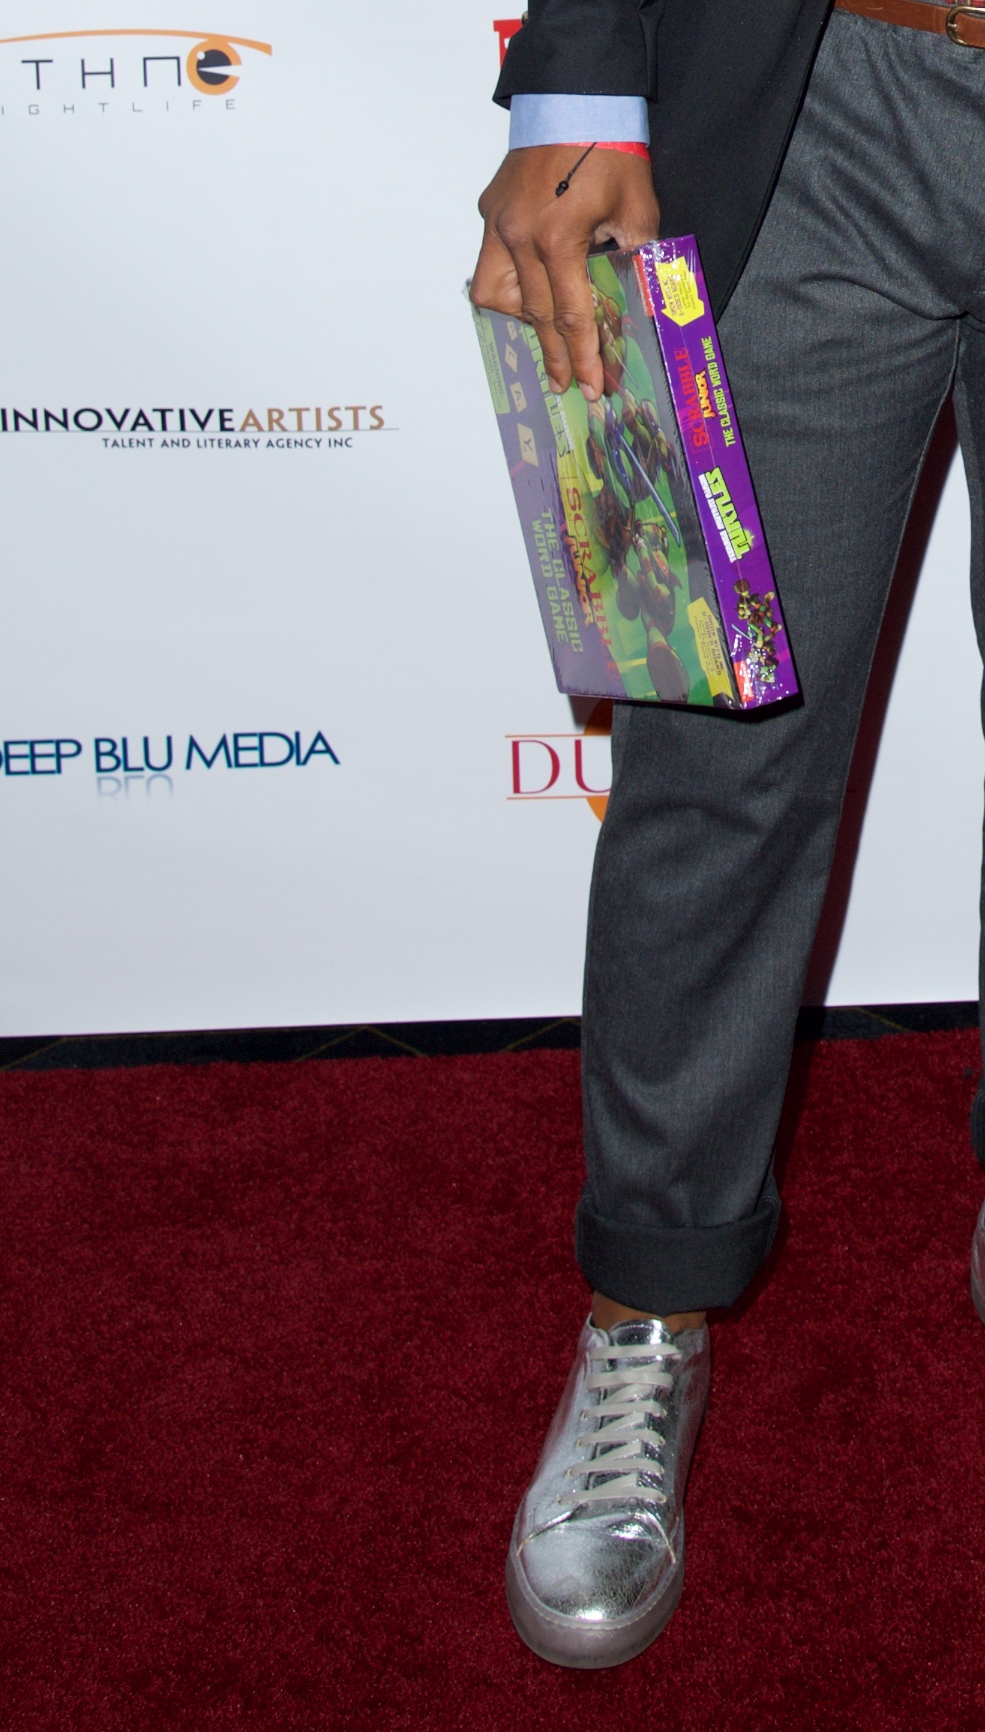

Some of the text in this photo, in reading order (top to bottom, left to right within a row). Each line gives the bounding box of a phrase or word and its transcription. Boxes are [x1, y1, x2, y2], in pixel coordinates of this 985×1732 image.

[674, 347, 709, 447] SCRABBLE
[694, 369, 716, 419] JUNIOR
[701, 335, 736, 447] THE CLASSIC WORD GAME
[101, 436, 353, 449] TALENT AND LITERARY AGENCY INC
[705, 466, 751, 560] TURTLES
[531, 520, 568, 644] WORD GAME
[541, 507, 584, 653] THE CLASSIC
[94, 735, 173, 773] BLU
[185, 731, 341, 770] MEDIA
